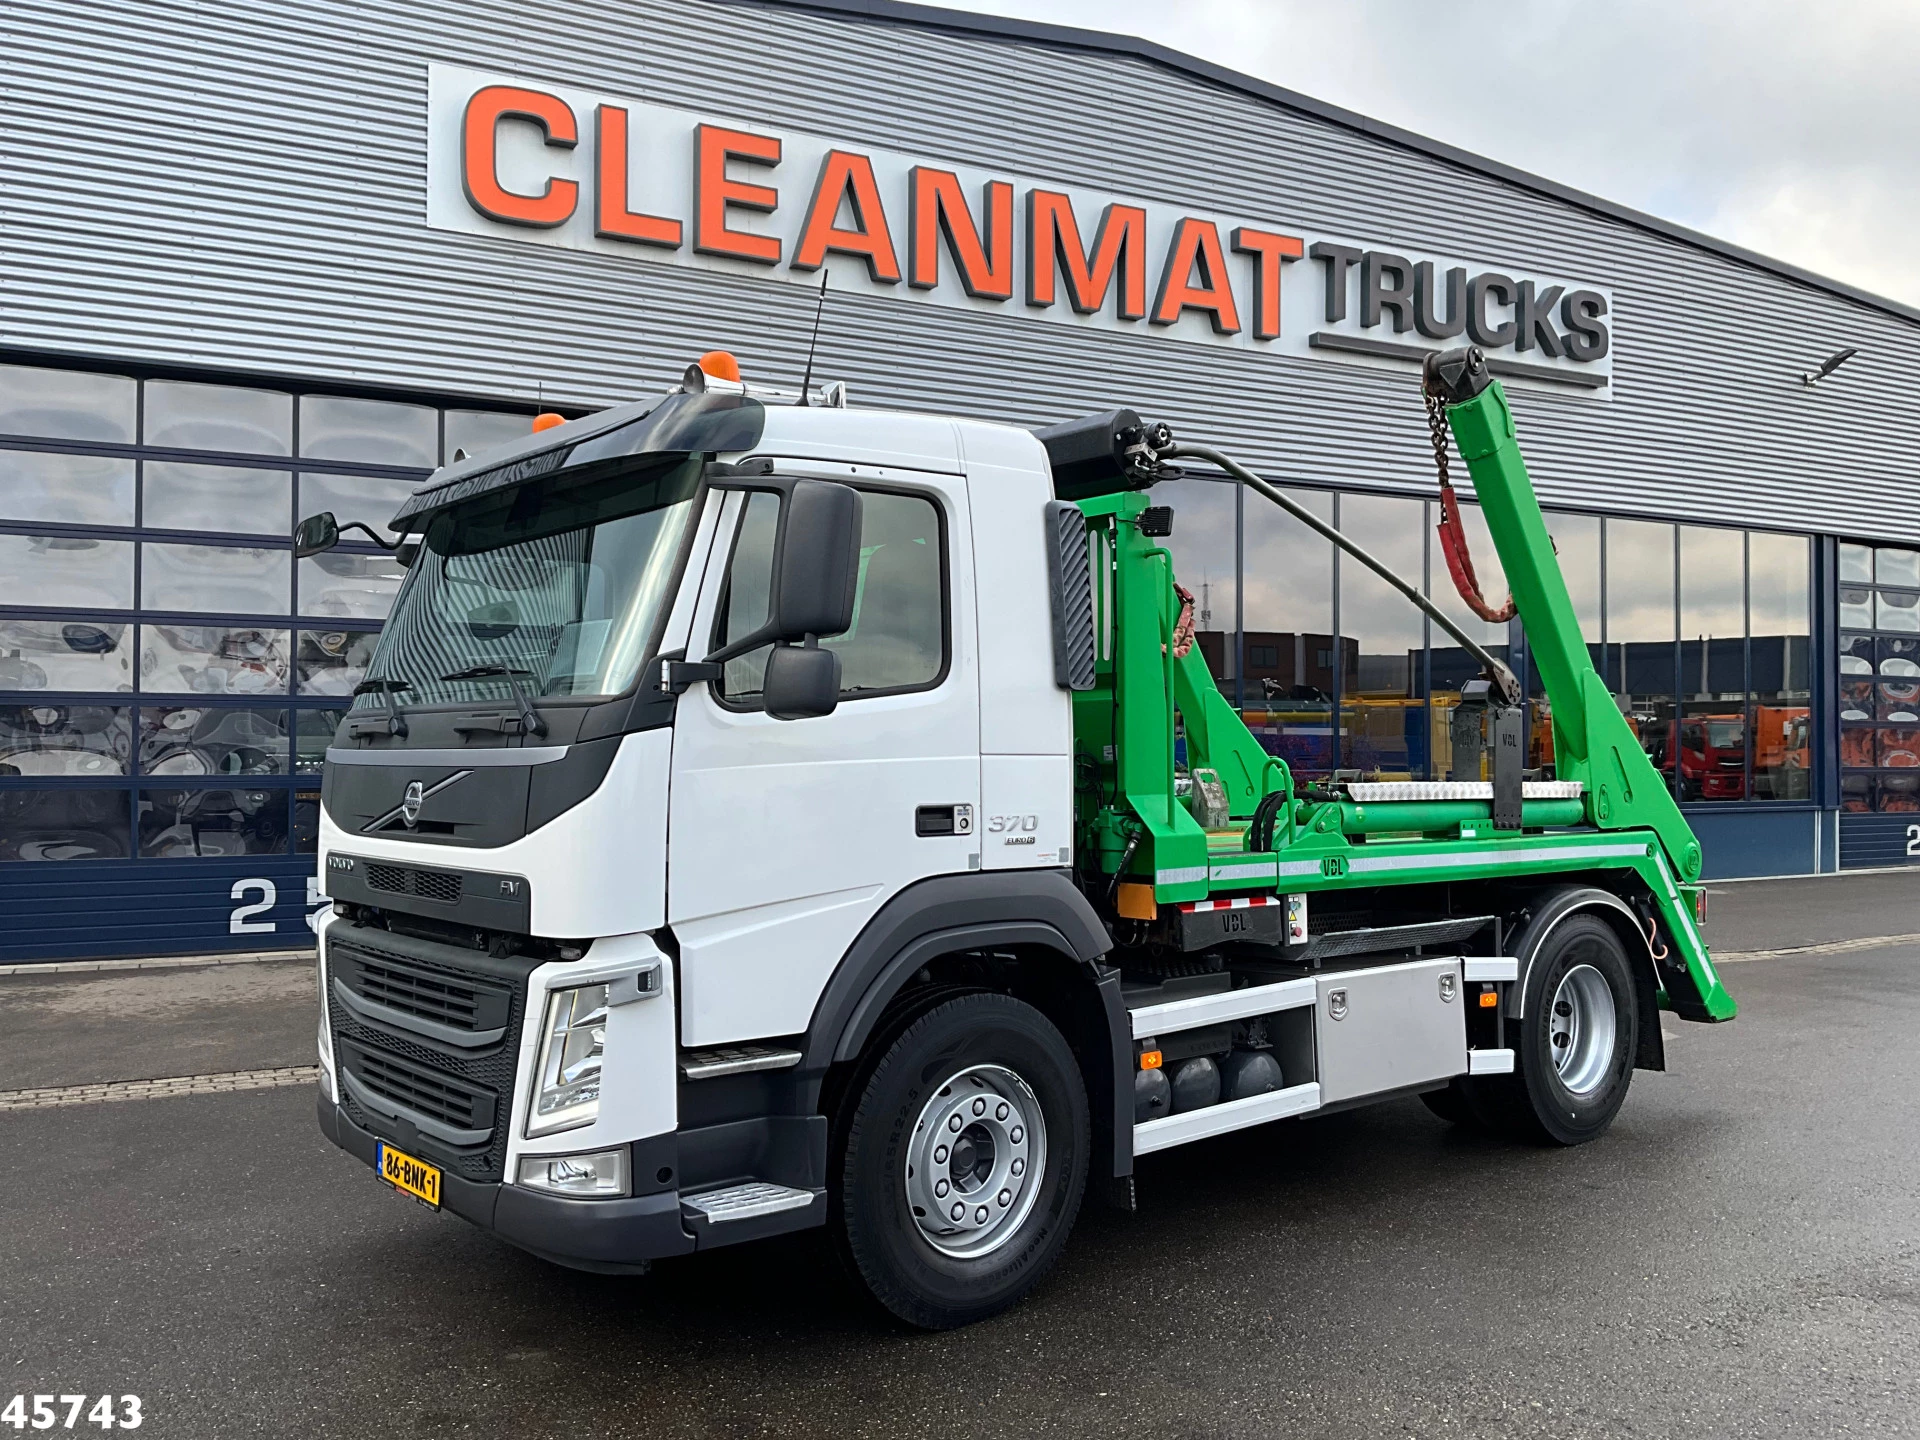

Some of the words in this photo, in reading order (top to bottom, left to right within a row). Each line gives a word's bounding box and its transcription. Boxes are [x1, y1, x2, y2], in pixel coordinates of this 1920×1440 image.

[461, 85, 1304, 340] CLEANMAT
[1309, 241, 1609, 362] TRUCKS
[988, 814, 1039, 832] 370
[1322, 857, 1344, 877] VDL
[500, 880, 520, 896] FM
[1221, 912, 1247, 933] VDL
[386, 1151, 437, 1199] 86-BNK-1
